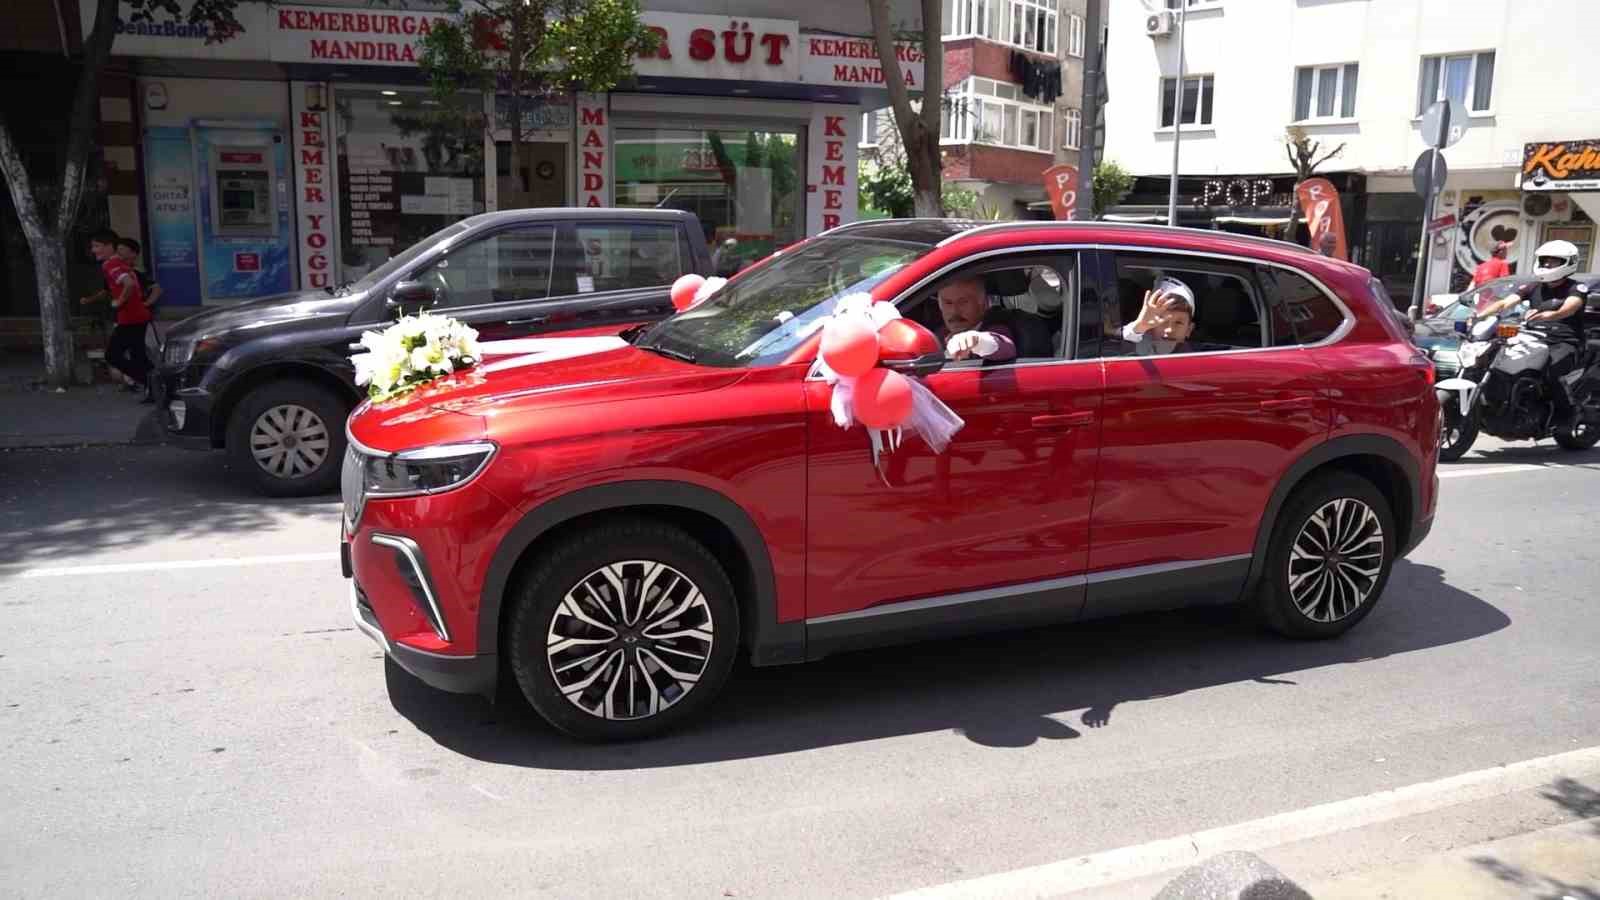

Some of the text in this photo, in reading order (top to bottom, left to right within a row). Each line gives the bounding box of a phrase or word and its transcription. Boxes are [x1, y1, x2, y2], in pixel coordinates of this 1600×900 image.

[310, 40, 416, 62] MANDIRA
[688, 21, 790, 65] SÜT
[809, 38, 928, 63] KEMERBRGA
[833, 64, 915, 86] MANDA
[300, 111, 325, 202] KEMER
[1203, 179, 1273, 206] POP
